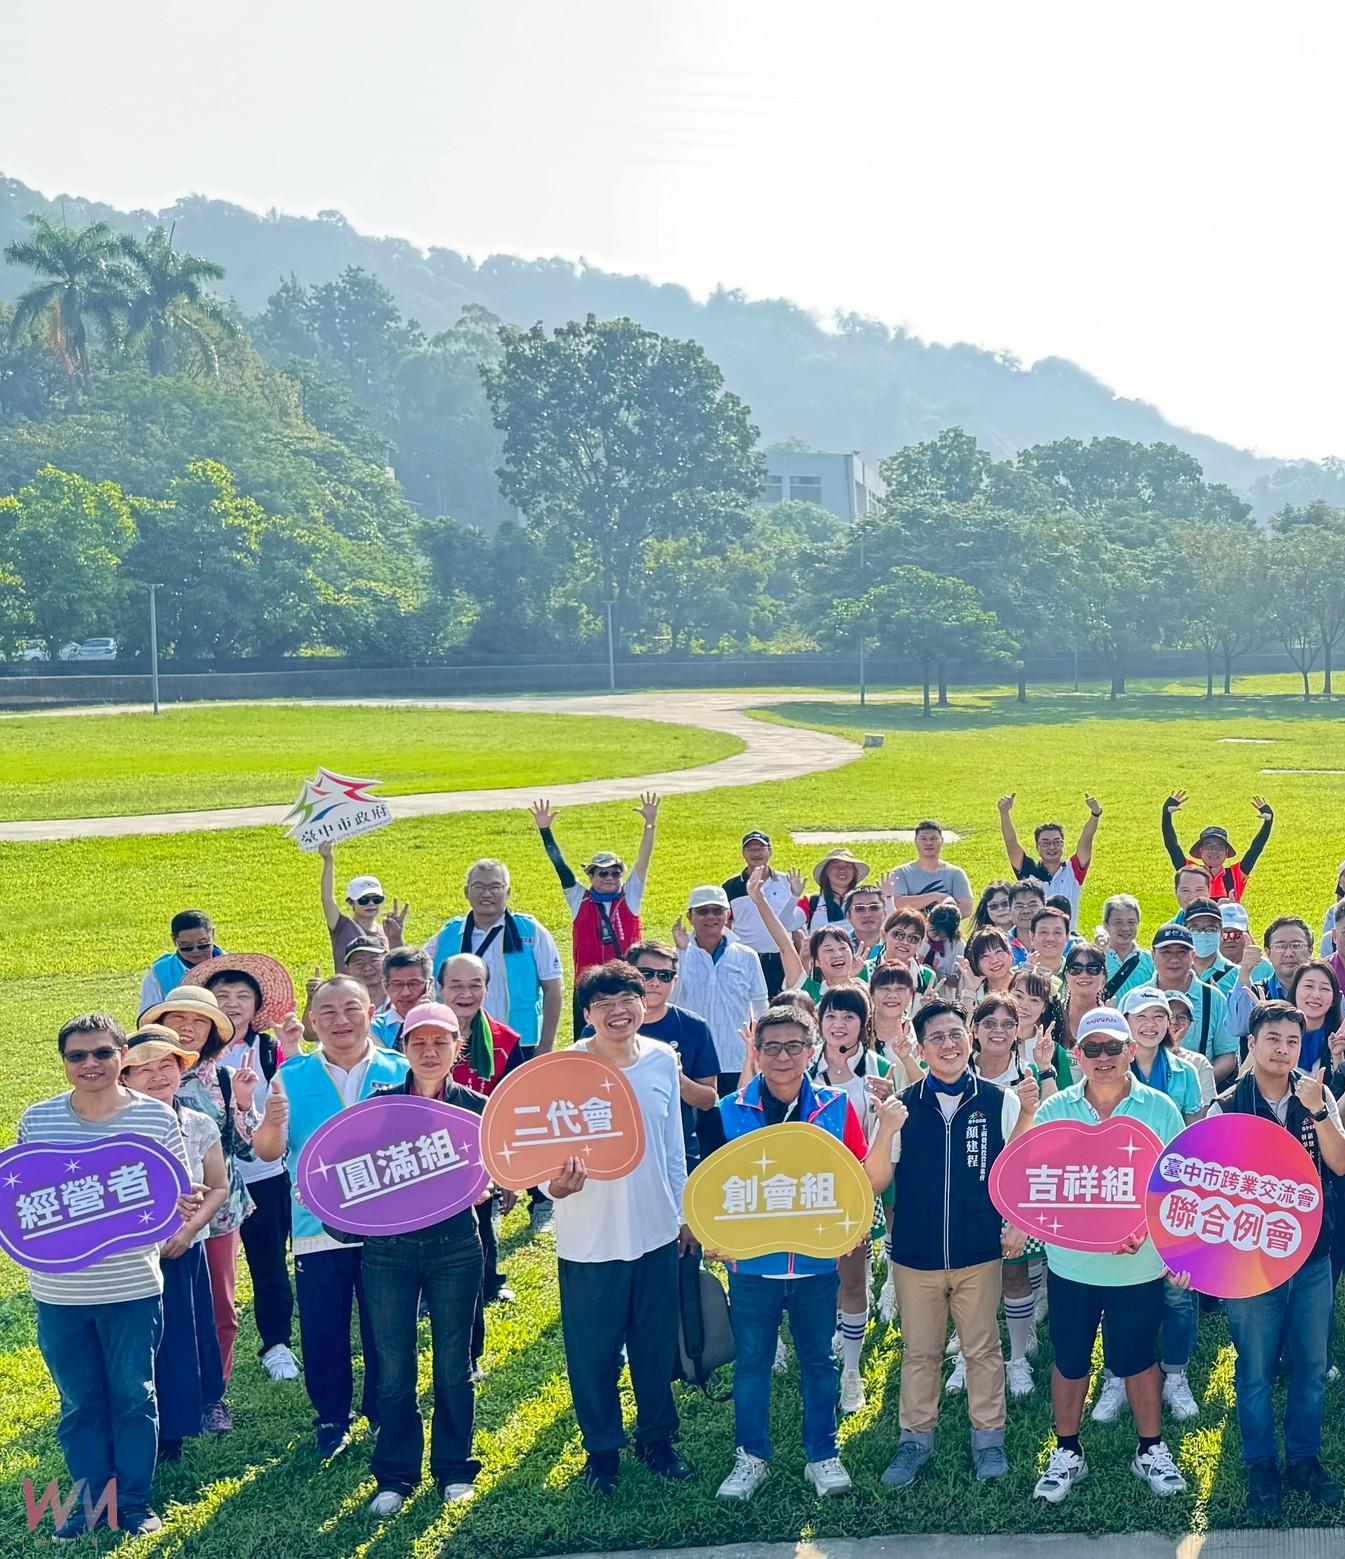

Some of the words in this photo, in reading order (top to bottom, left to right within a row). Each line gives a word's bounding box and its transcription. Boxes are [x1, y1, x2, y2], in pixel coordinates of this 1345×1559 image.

[301, 804, 387, 843] 臺中市政府
[513, 1097, 612, 1137] 二代會
[335, 1128, 460, 1200] 圓滿組
[966, 1126, 979, 1168] 顏建程
[16, 1161, 150, 1230] 經營者
[722, 1172, 837, 1213] 創會組
[1025, 1164, 1136, 1202] 吉祥組
[1164, 1157, 1315, 1208] 臺中市跨業交流會
[1166, 1194, 1296, 1252] 聯合例會
